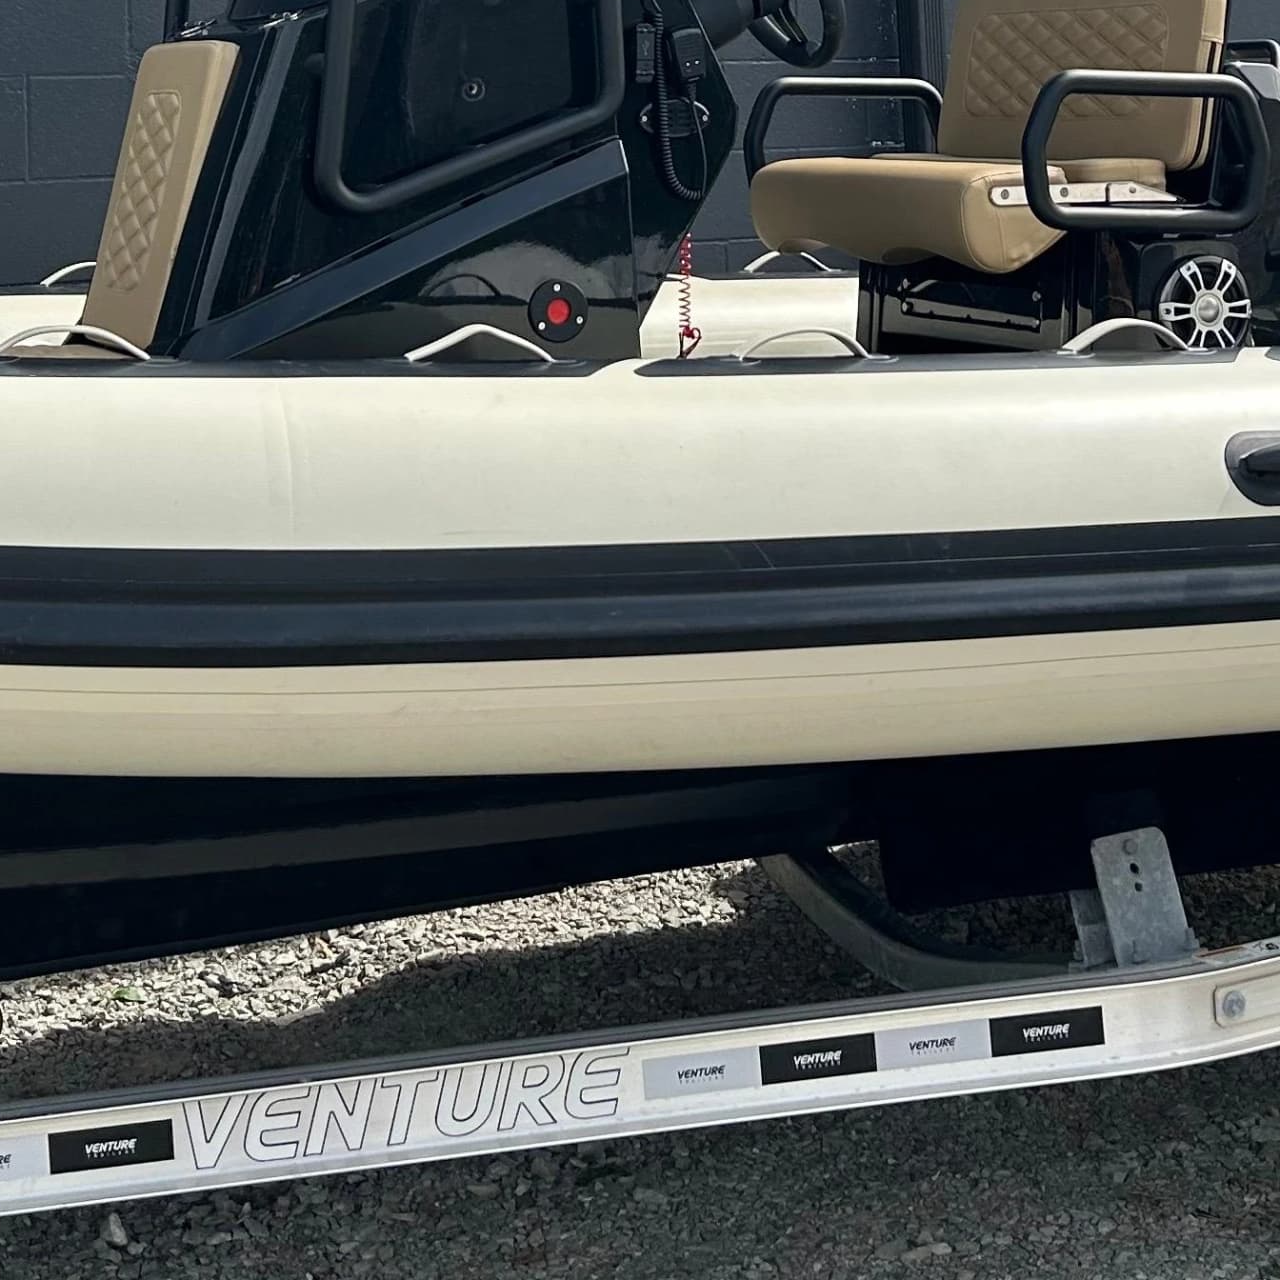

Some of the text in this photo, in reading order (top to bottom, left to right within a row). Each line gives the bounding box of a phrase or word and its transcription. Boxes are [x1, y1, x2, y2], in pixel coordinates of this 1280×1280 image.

[1022, 1023, 1071, 1039] VENTURE
[908, 1036, 957, 1052] VENTURE
[793, 1049, 842, 1066] VENTURE
[677, 1064, 726, 1081] VENTURE
[182, 1045, 631, 1170] VENTURE
[85, 1138, 137, 1155] VENTURE
